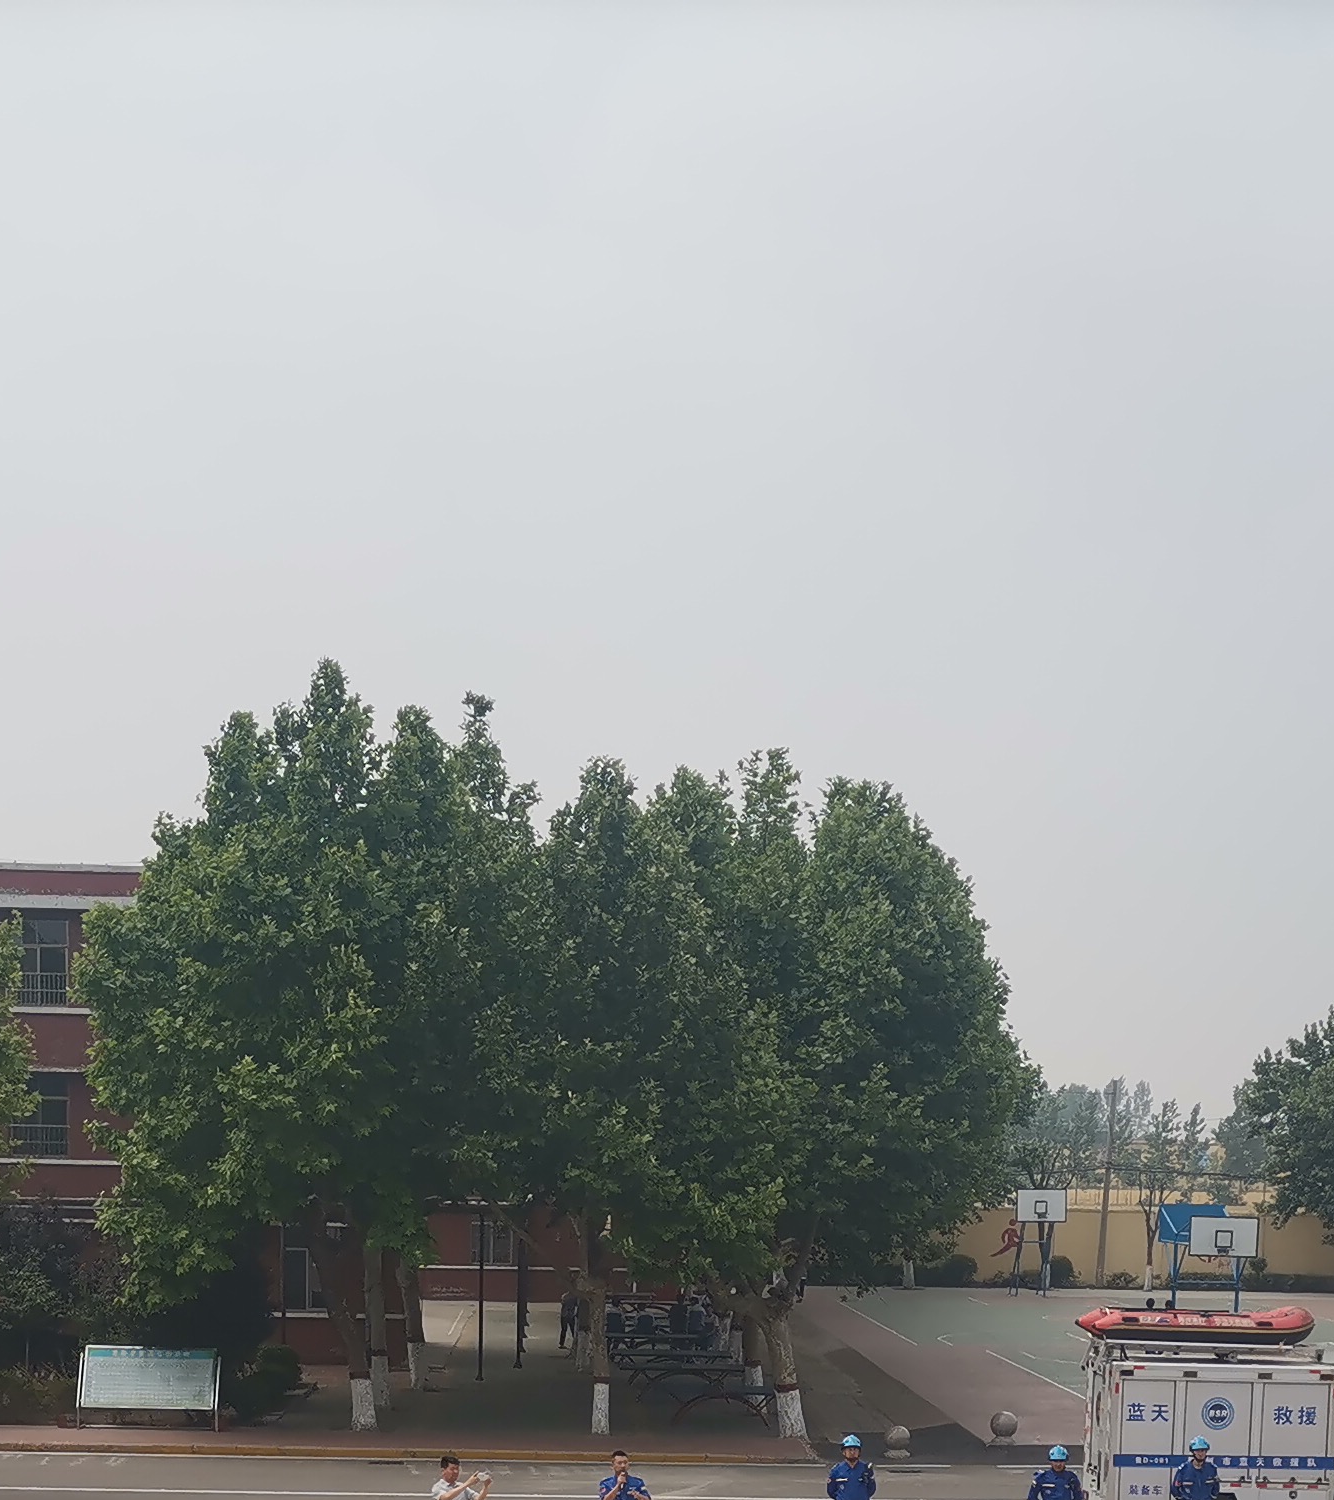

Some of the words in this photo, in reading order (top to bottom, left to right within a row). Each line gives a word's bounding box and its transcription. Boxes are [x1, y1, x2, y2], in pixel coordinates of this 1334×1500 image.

[1125, 1403, 1170, 1422] 蓝天
[1273, 1406, 1317, 1425] 救援
[1208, 1409, 1228, 1418] BSR
[1128, 1484, 1164, 1496] 装备车
